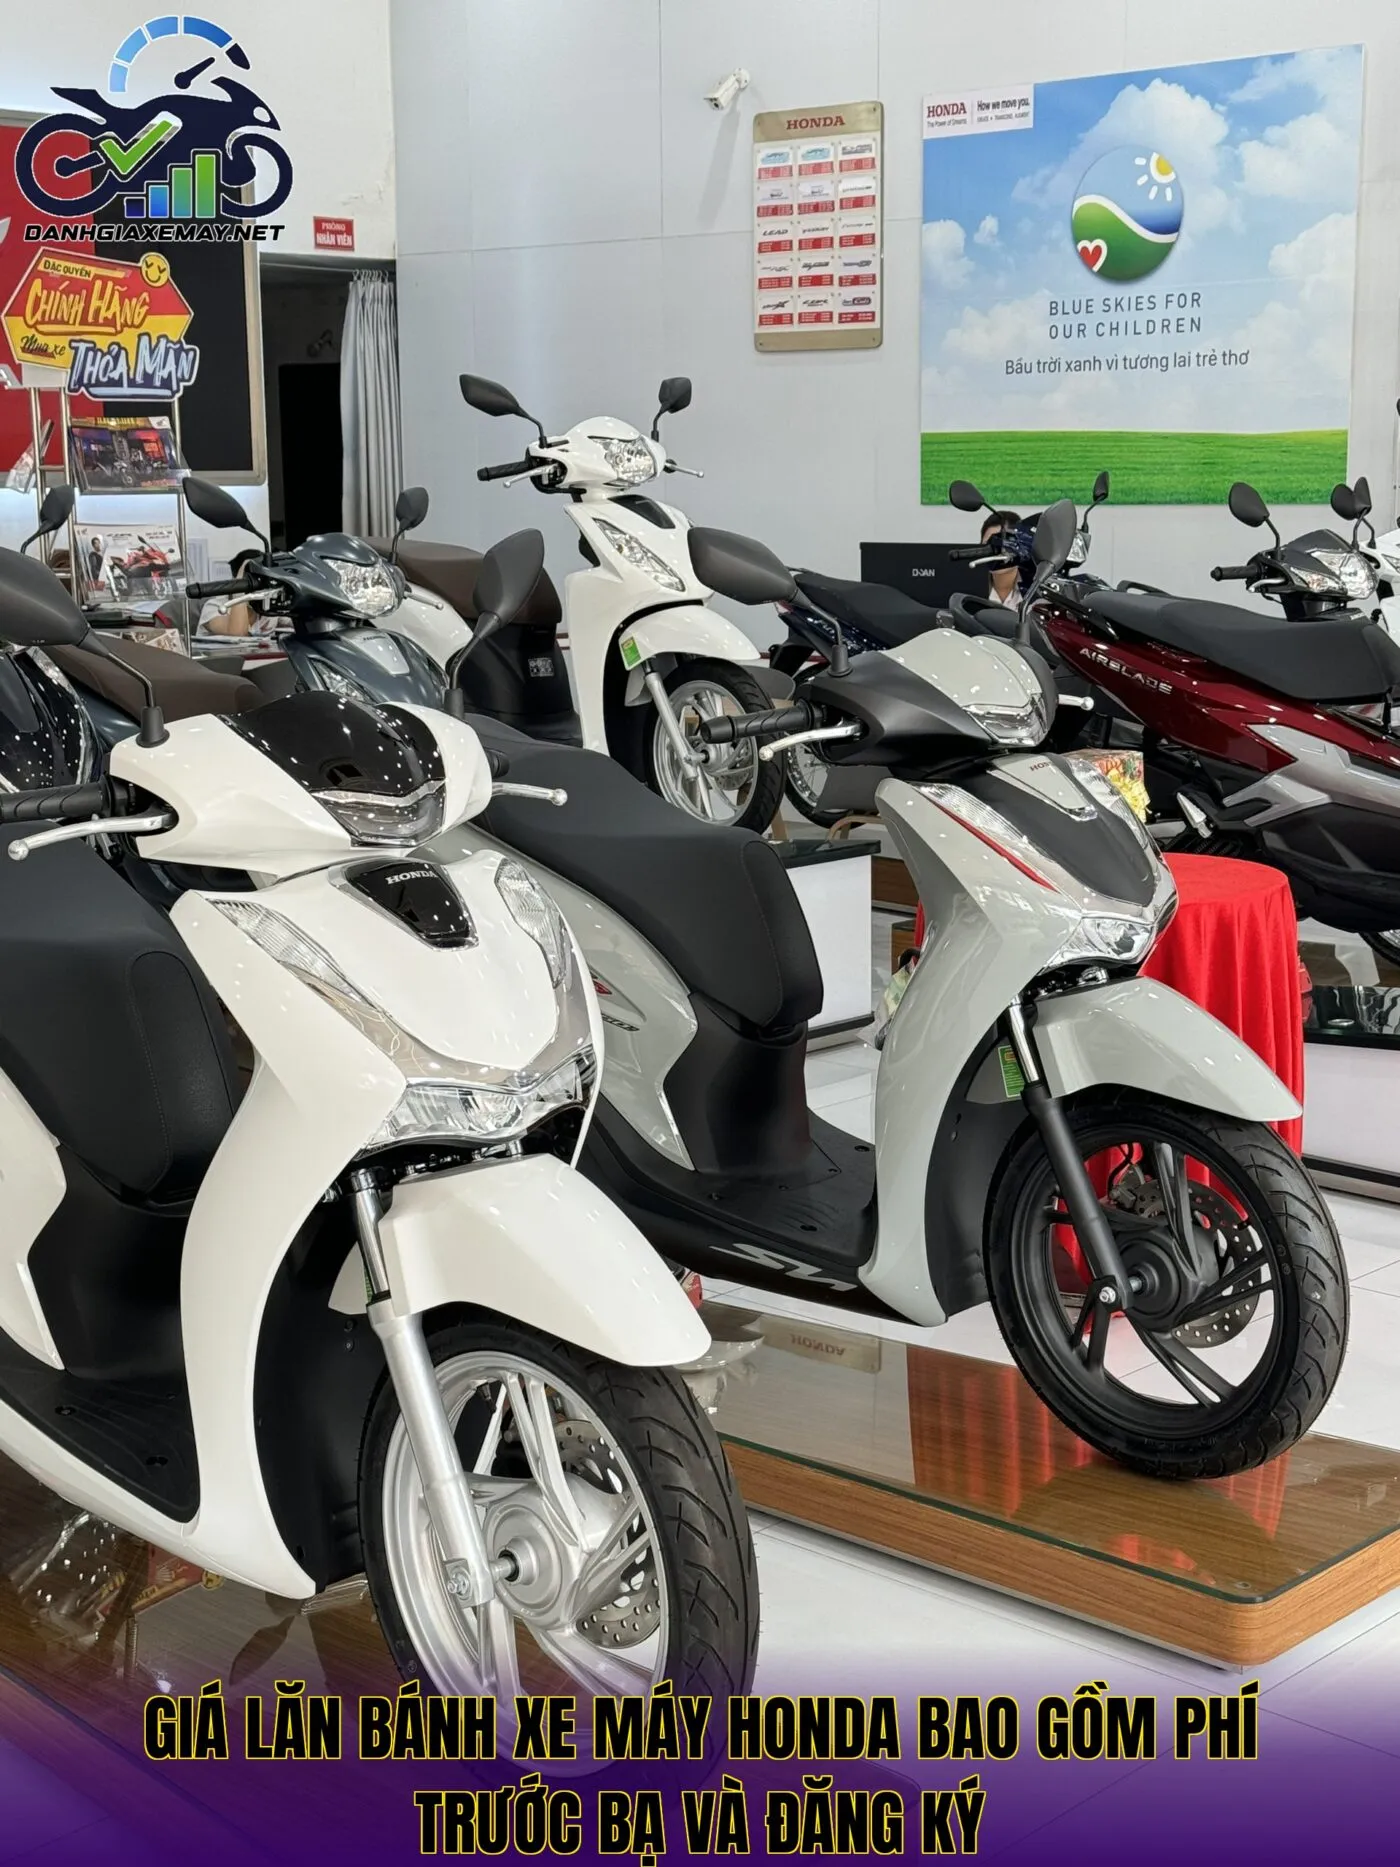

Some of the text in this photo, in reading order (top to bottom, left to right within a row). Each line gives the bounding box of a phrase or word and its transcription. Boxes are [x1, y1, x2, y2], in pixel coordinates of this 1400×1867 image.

[926, 101, 968, 118] HONDA
[786, 115, 846, 130] HONDA
[25, 278, 87, 327] CHÍNH
[1049, 292, 1201, 316] BLUE SKIES FOR
[1049, 317, 1201, 340] OUR CHILDREN
[1036, 356, 1061, 373] trời
[1065, 356, 1101, 372] xanh
[1106, 354, 1118, 371] vì
[1122, 354, 1169, 373] tương
[1173, 351, 1191, 368] lai
[1195, 348, 1217, 367] trẻ
[1221, 349, 1250, 366] thơ
[385, 870, 438, 885] HONDA
